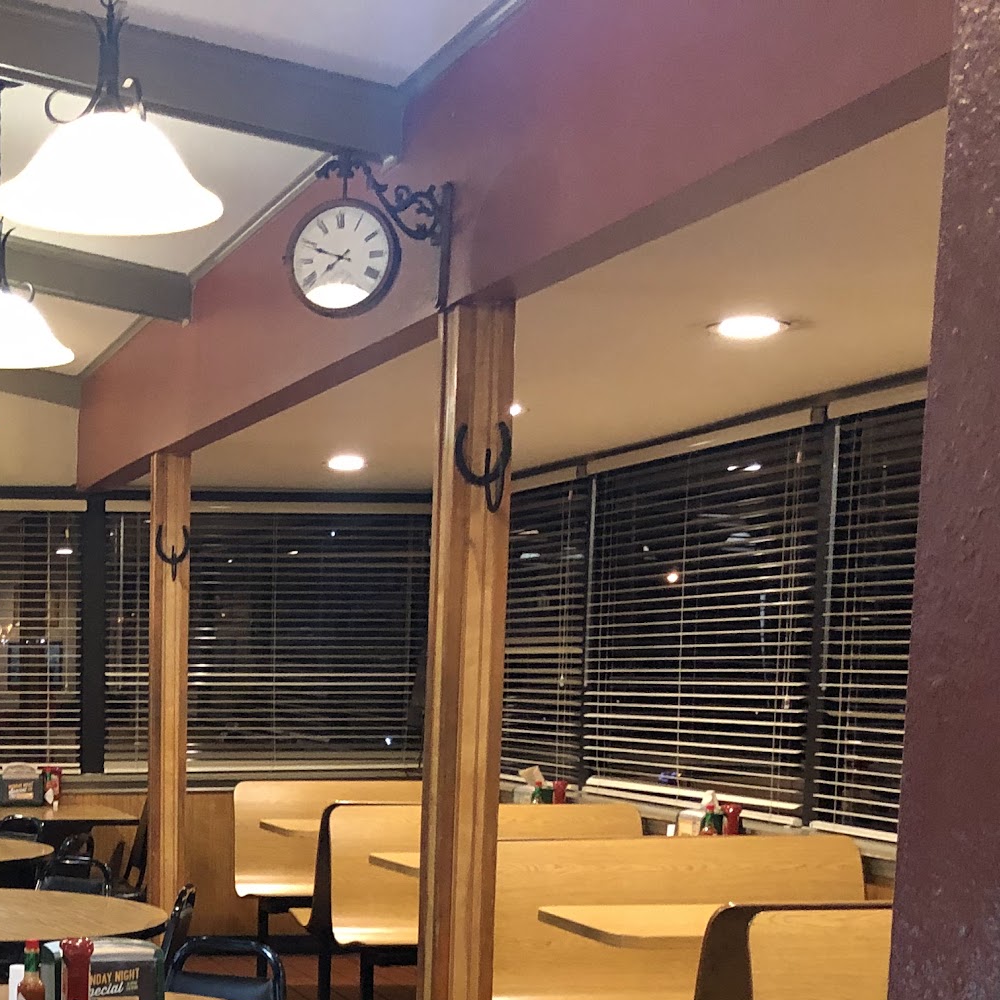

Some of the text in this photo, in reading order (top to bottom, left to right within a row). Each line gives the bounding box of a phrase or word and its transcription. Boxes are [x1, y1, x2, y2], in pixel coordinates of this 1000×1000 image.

[90, 971, 112, 986] NDAY
[114, 967, 140, 983] NIGHT
[90, 981, 124, 997] pecial
